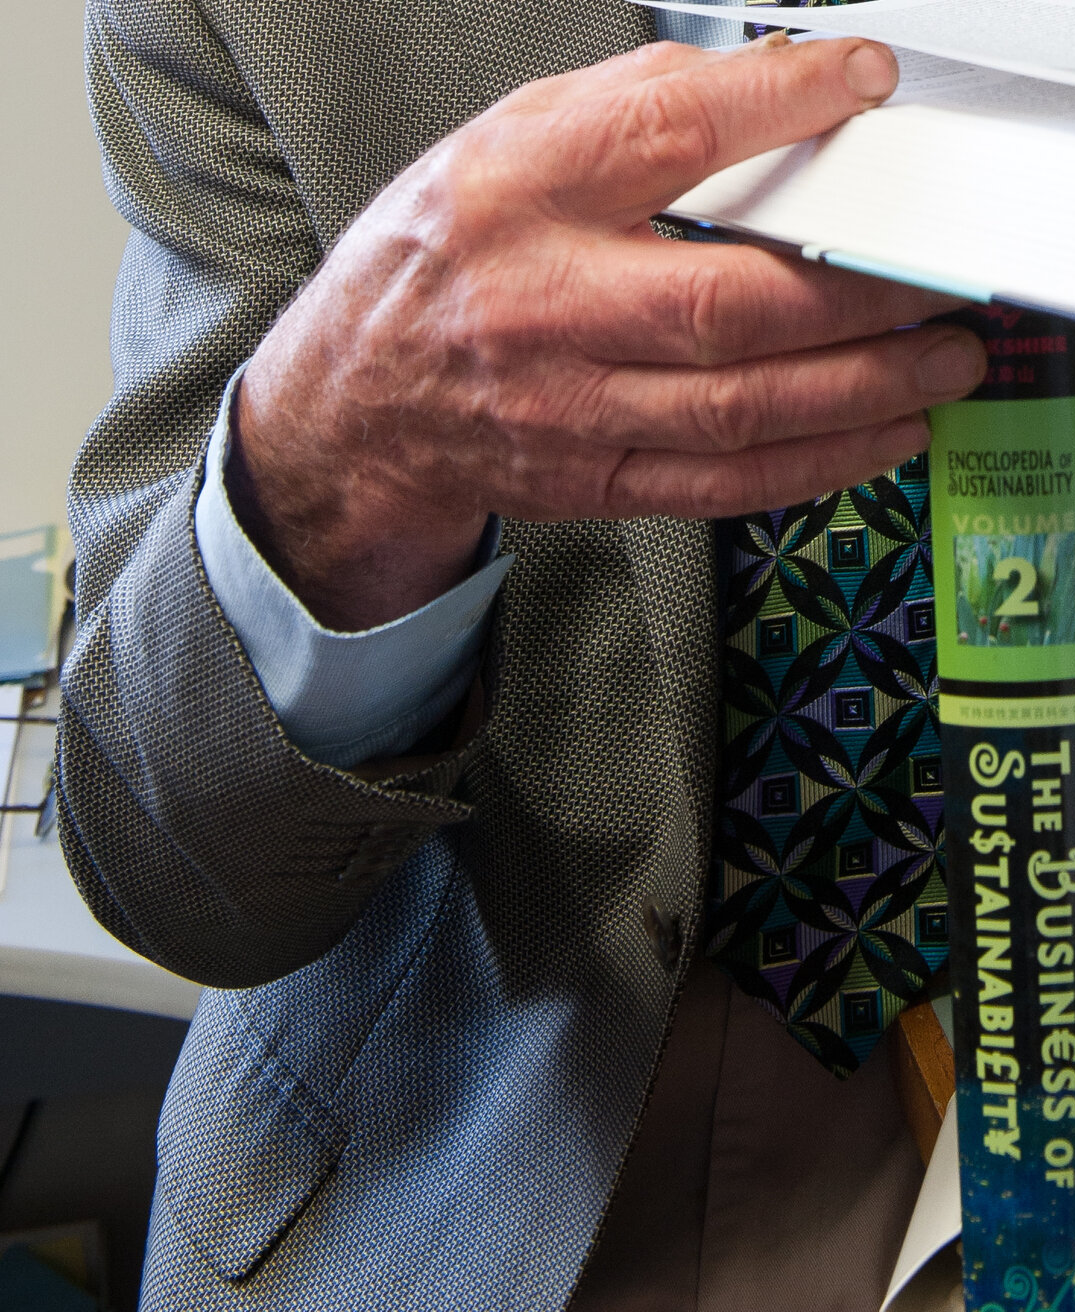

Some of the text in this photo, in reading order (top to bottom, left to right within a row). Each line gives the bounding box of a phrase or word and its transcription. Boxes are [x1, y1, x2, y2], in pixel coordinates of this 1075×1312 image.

[987, 334, 1068, 357] KSHIRE
[947, 448, 1055, 473] ENCYCLOPEDIA
[946, 470, 1075, 499] SUSTAINABILITY
[992, 557, 1041, 619] 2
[1031, 740, 1071, 834] THE
[1043, 1140, 1075, 1191] OF
